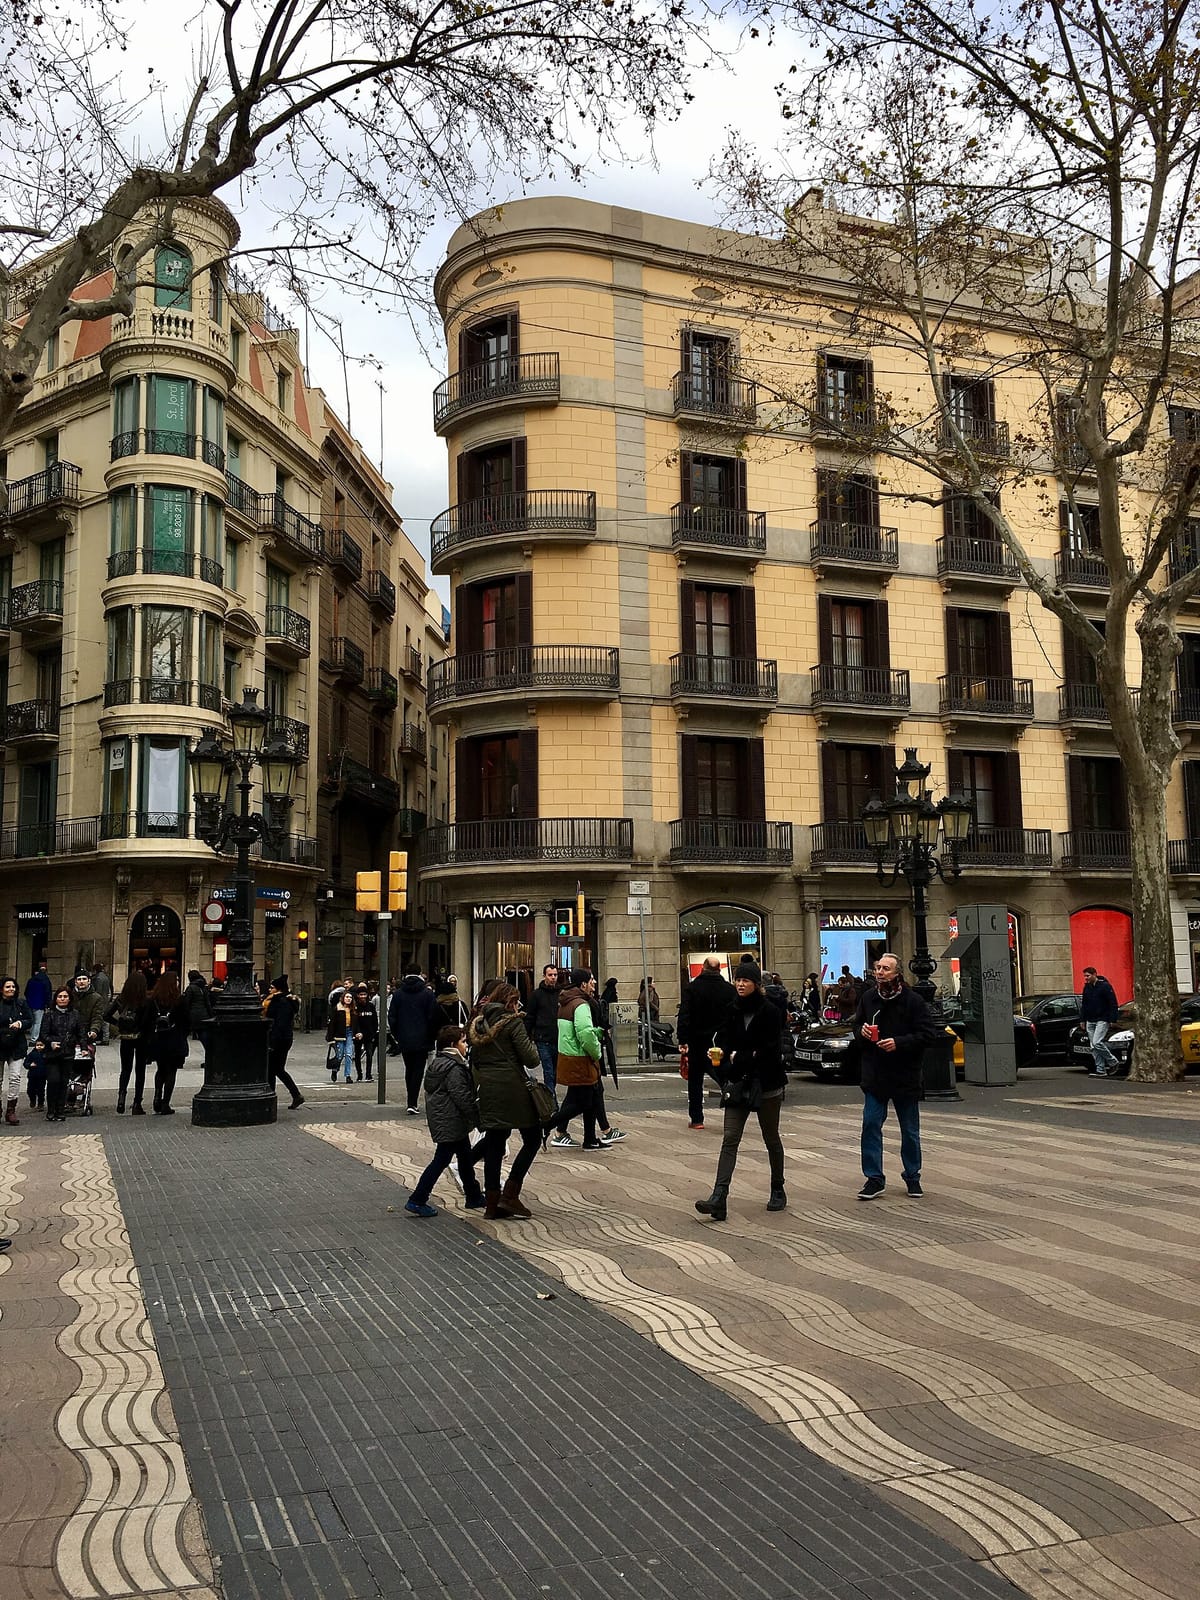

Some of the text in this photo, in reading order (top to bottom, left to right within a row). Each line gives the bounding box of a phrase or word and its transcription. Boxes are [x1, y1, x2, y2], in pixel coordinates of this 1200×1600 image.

[168, 384, 180, 406] Jordi
[174, 493, 182, 501] 11
[174, 504, 182, 512] 21
[174, 528, 182, 538] 93
[474, 904, 530, 919] MANGO
[829, 914, 888, 927] MANGO
